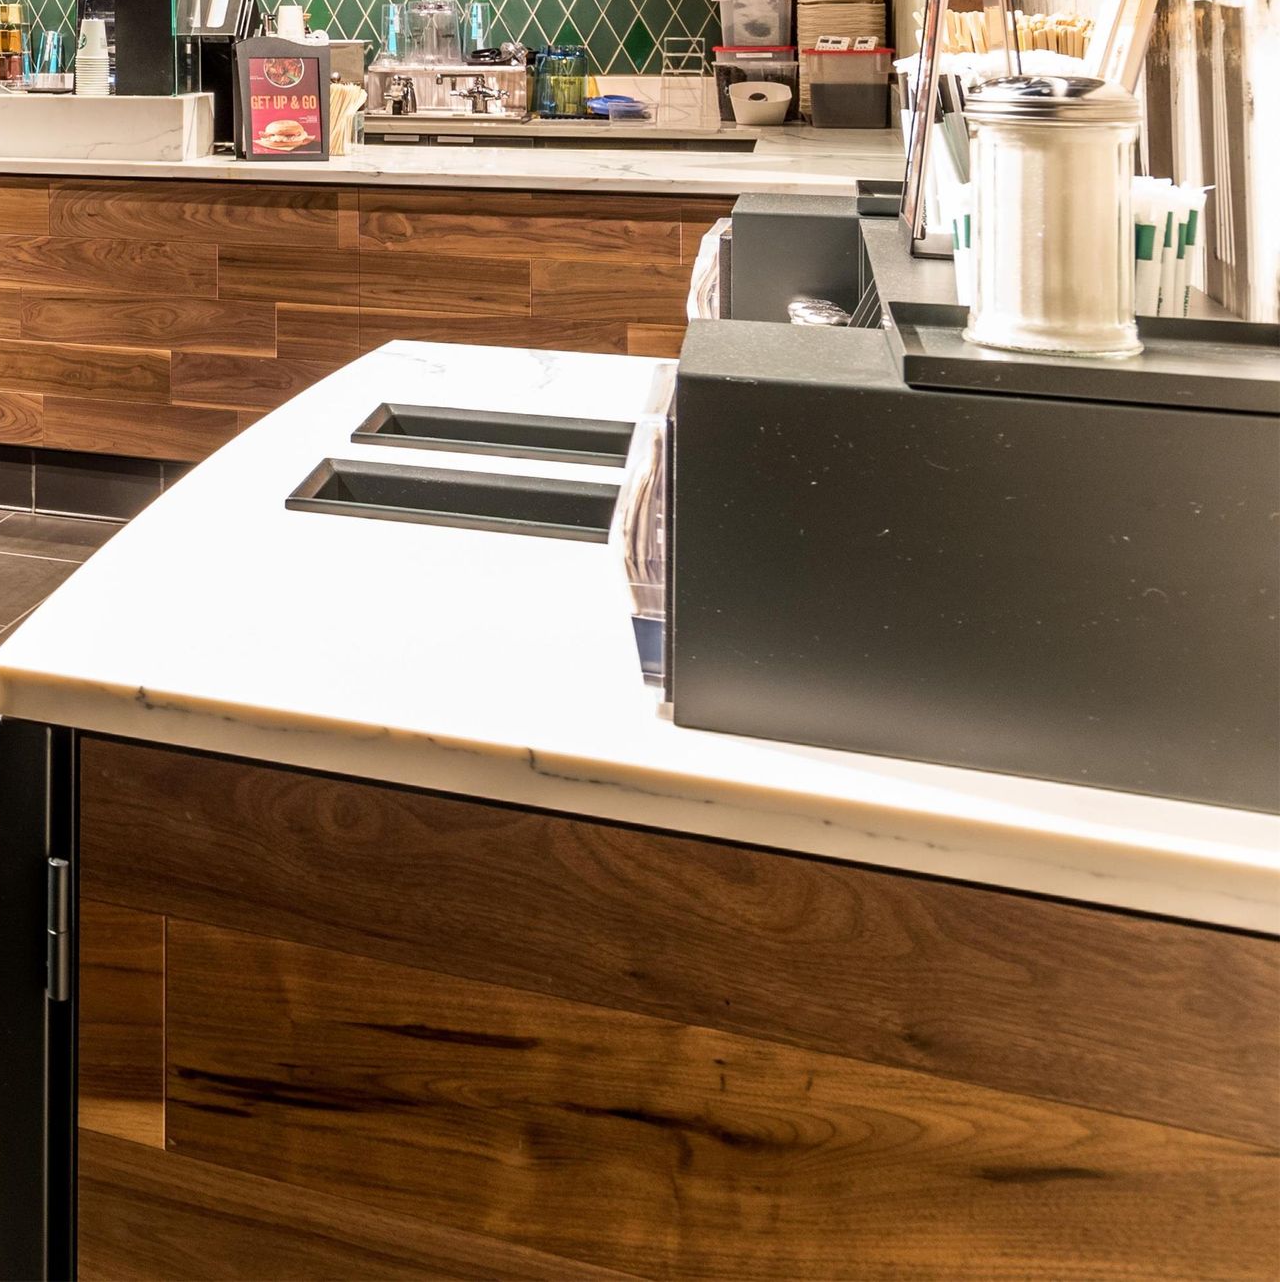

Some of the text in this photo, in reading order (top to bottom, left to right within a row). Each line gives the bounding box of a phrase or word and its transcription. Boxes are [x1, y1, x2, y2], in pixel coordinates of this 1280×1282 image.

[251, 95, 317, 110] GET UP & GO
